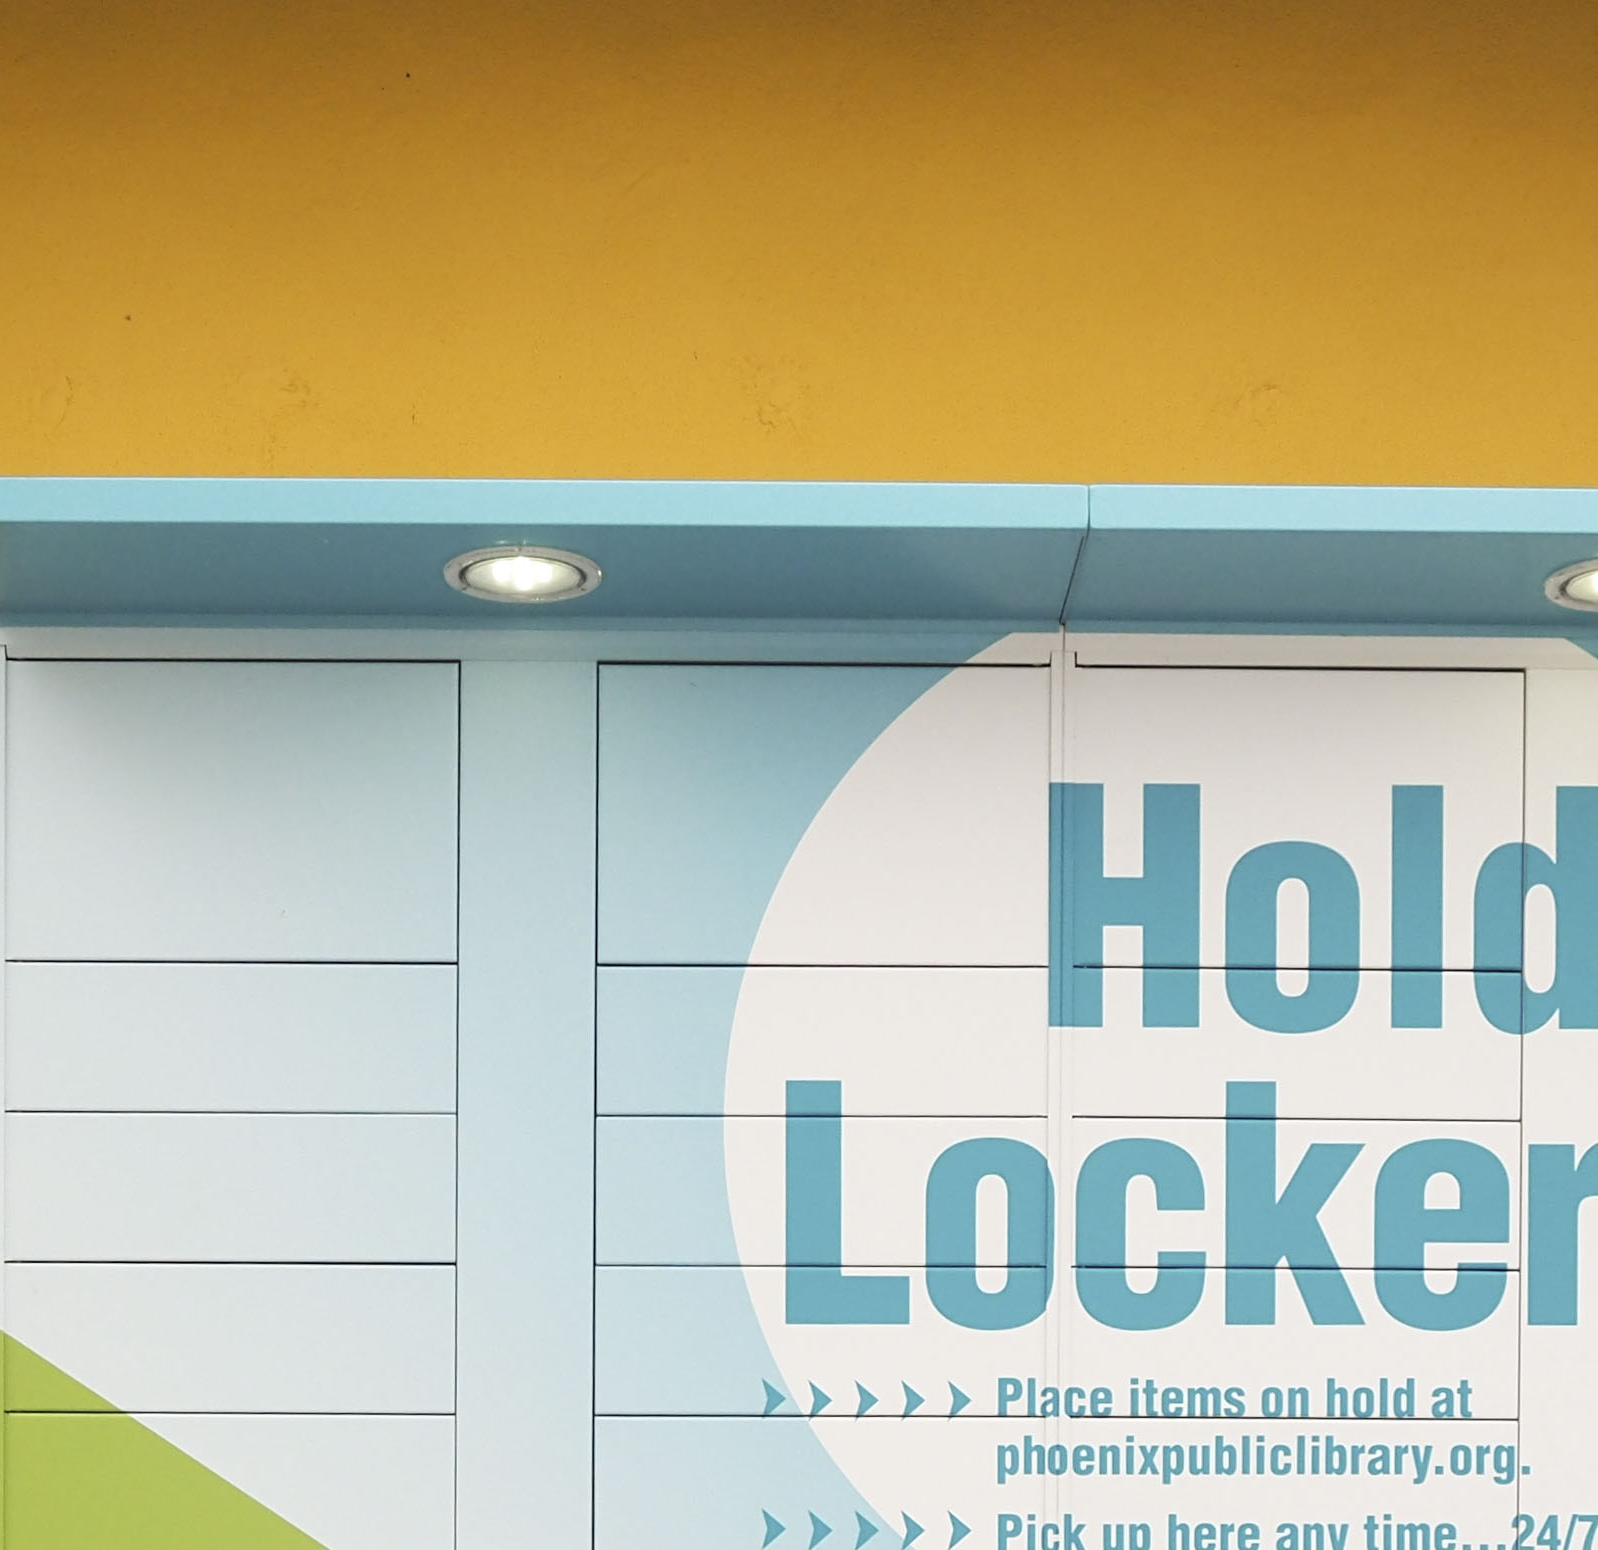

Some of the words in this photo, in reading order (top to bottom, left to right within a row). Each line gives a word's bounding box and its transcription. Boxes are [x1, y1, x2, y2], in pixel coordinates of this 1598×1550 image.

[996, 1378, 1113, 1419] Place
[1130, 1378, 1244, 1419] items
[1260, 1388, 1313, 1419] on
[1326, 1378, 1417, 1419] hold
[1430, 1380, 1474, 1419] at
[996, 1434, 1532, 1484] phoenixpubliclibrary.org.
